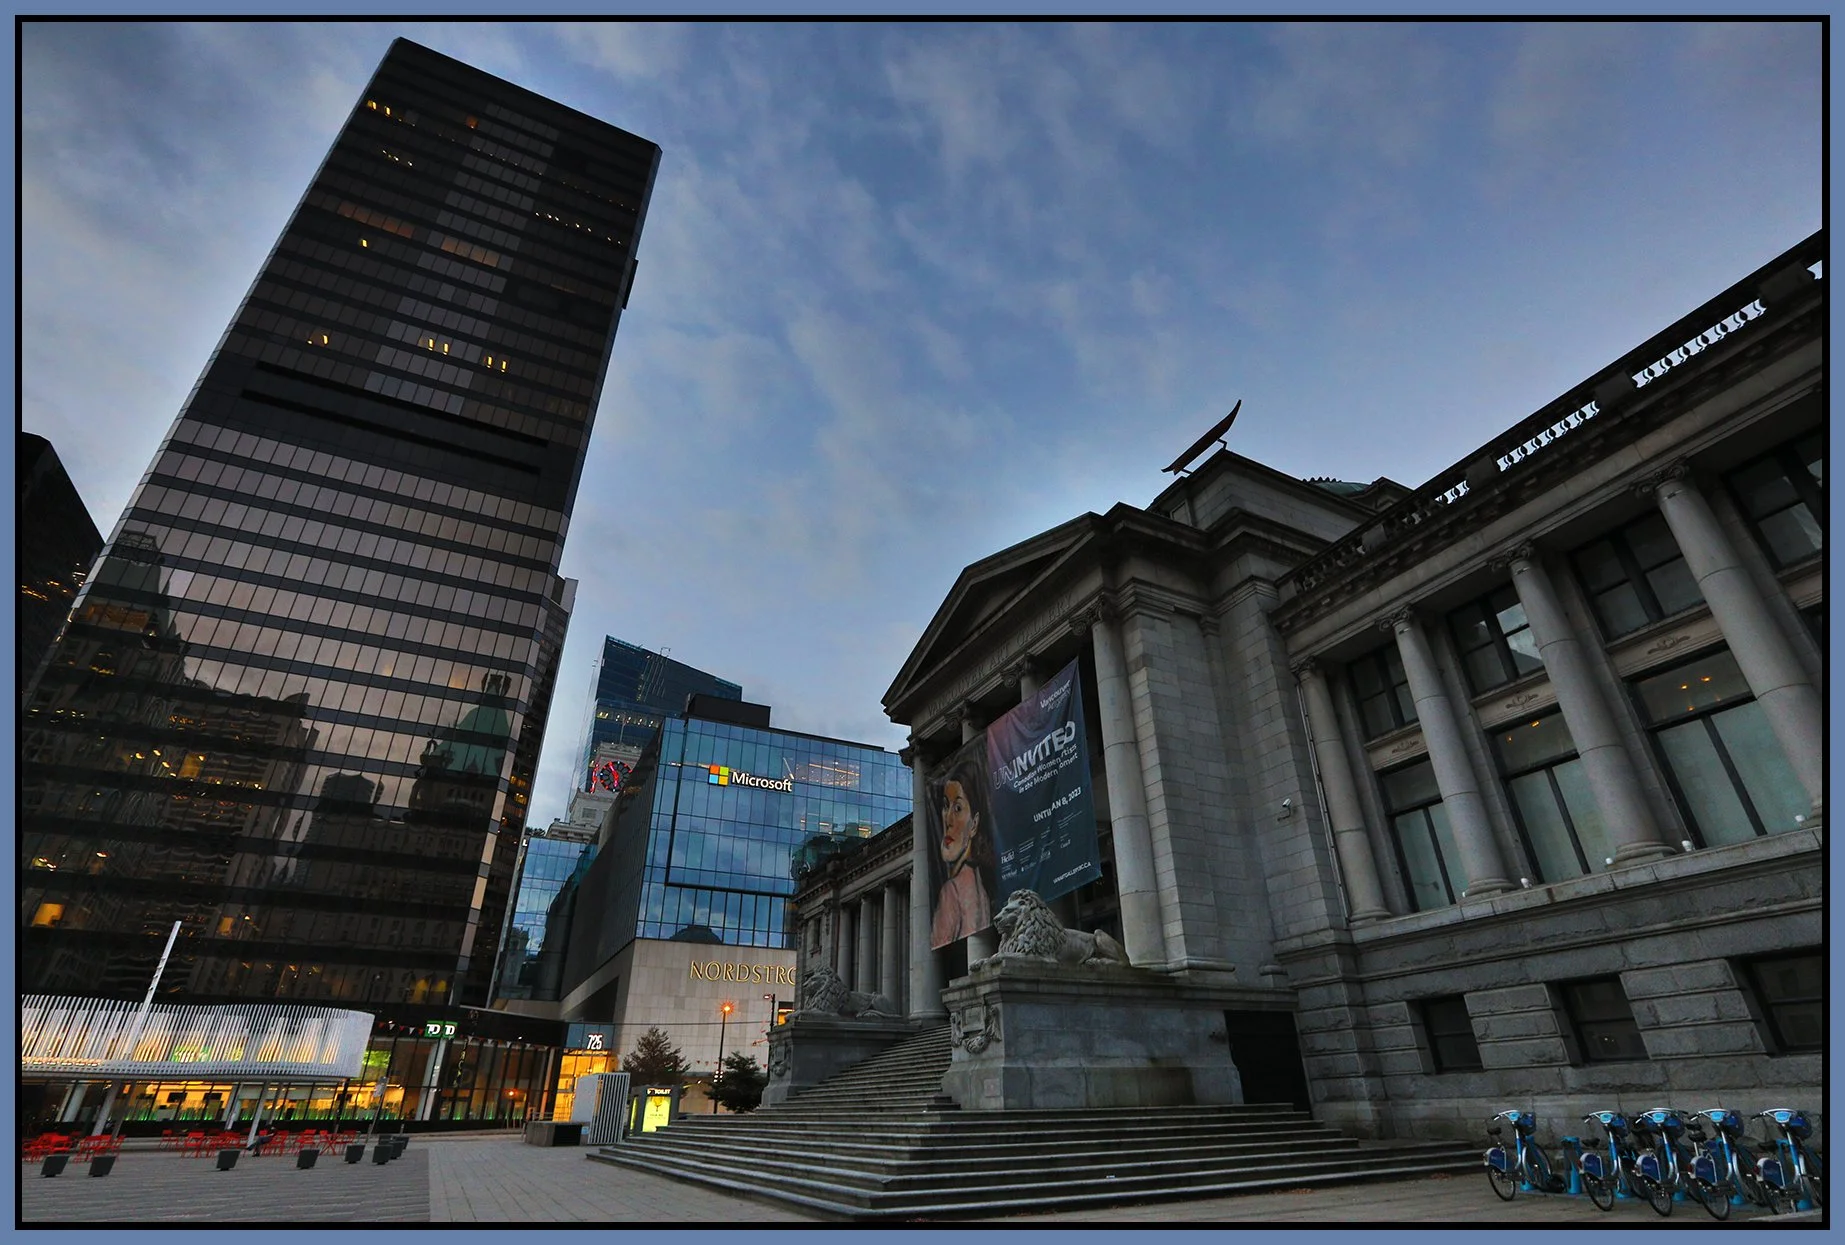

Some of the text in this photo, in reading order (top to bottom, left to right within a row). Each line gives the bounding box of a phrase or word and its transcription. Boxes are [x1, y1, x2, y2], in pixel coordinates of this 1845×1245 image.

[993, 721, 1076, 789] UNINVITED
[1033, 768, 1059, 785] Modern
[1058, 752, 1078, 769] oment
[1036, 757, 1061, 773] Women
[731, 771, 793, 792] Microsoft
[1068, 787, 1081, 801] 2023
[587, 1034, 603, 1050] 725
